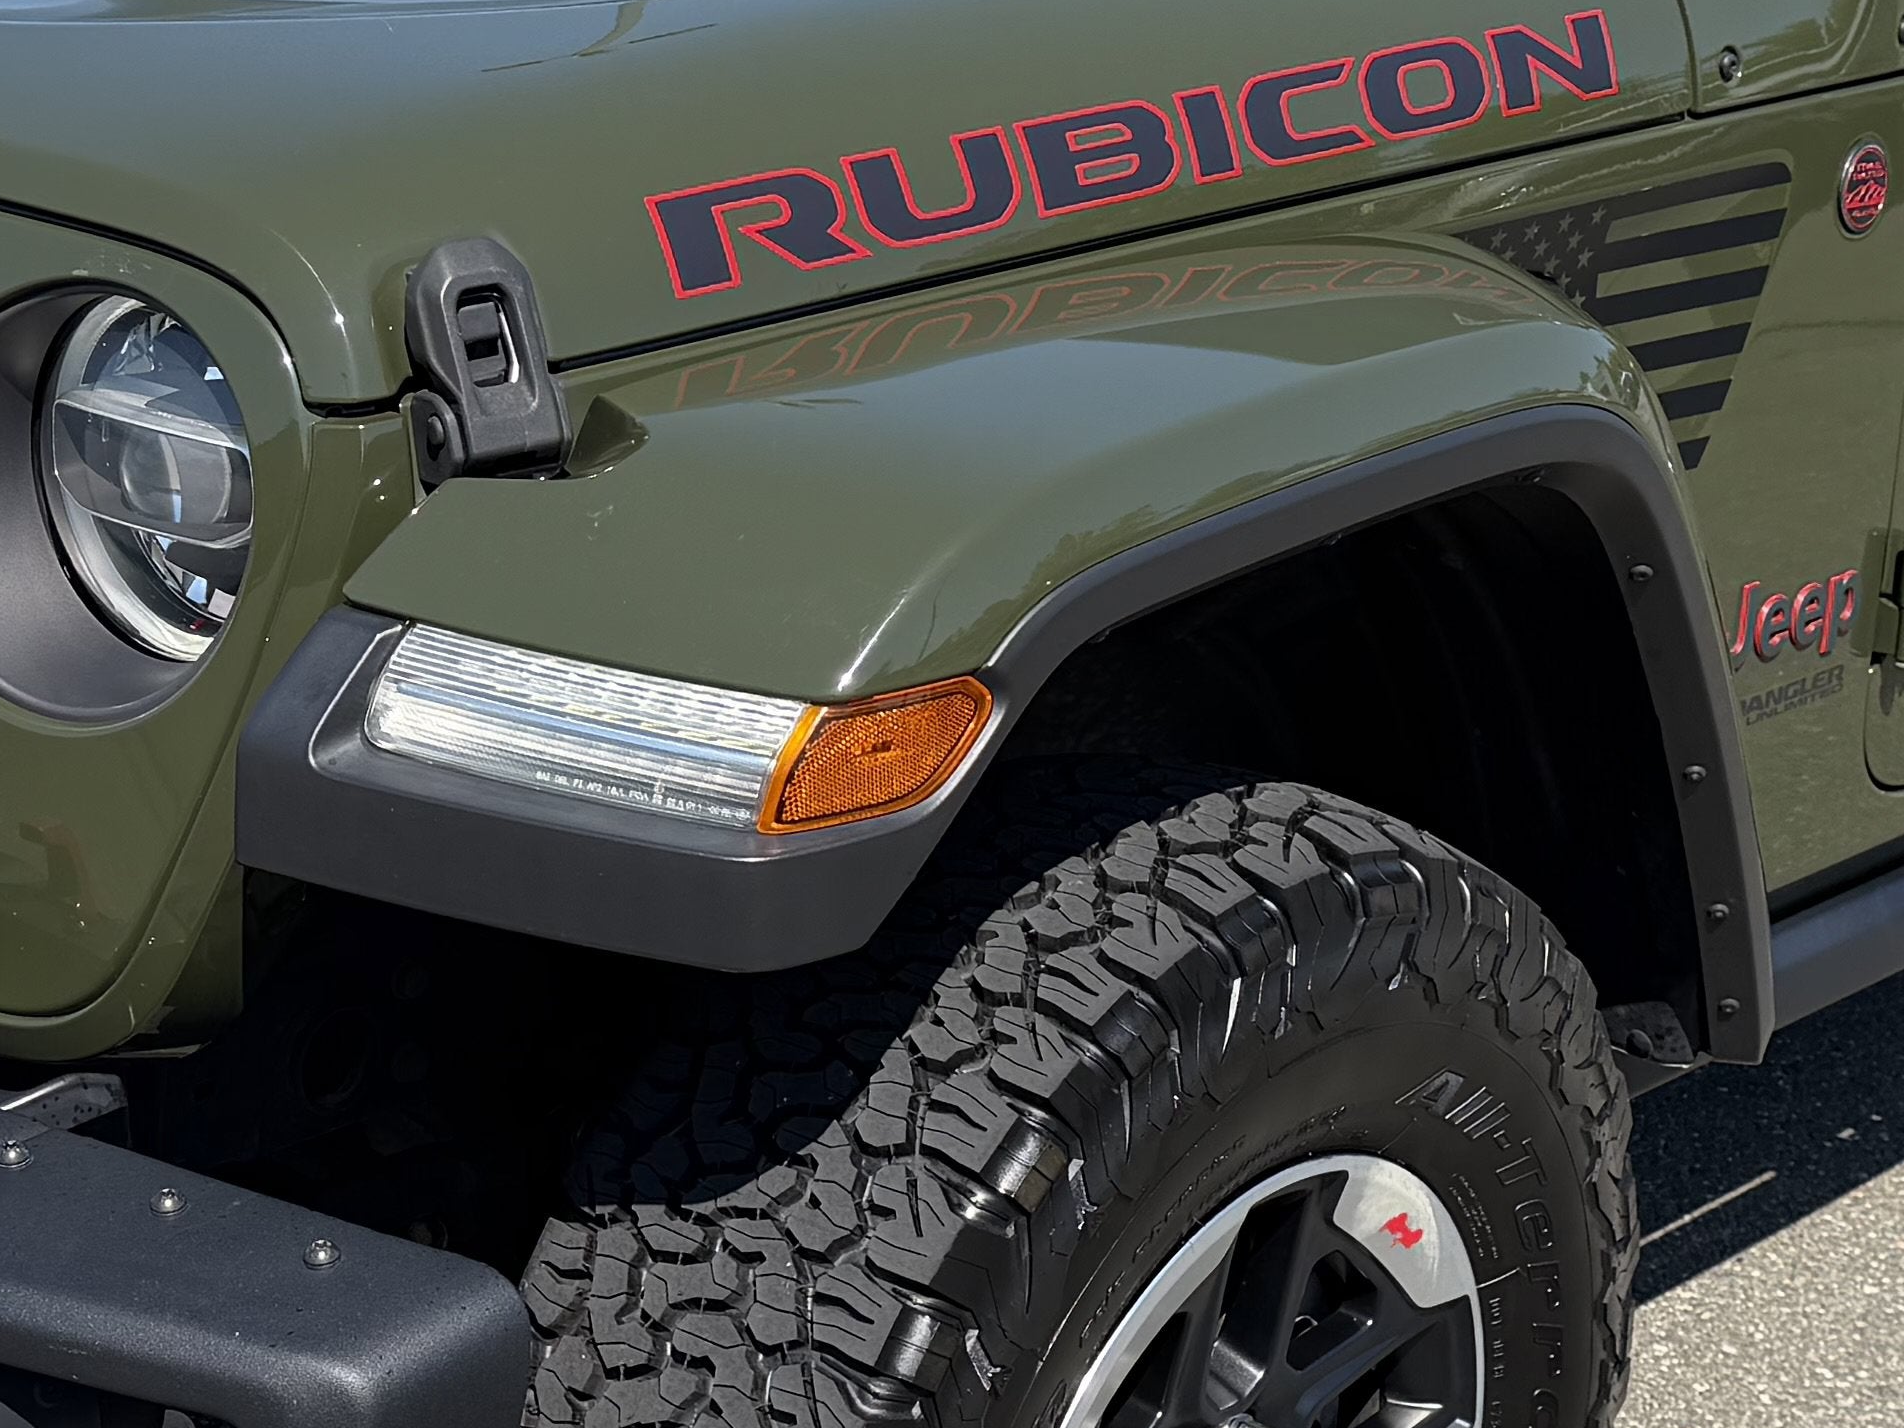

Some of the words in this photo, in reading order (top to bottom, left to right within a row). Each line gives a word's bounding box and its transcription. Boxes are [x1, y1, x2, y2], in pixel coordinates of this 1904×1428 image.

[644, 9, 1619, 299] RUBICON
[1729, 569, 1860, 672] Jeep
[1740, 664, 1845, 717] ANGLER
[1746, 683, 1845, 726] UNLIMITED
